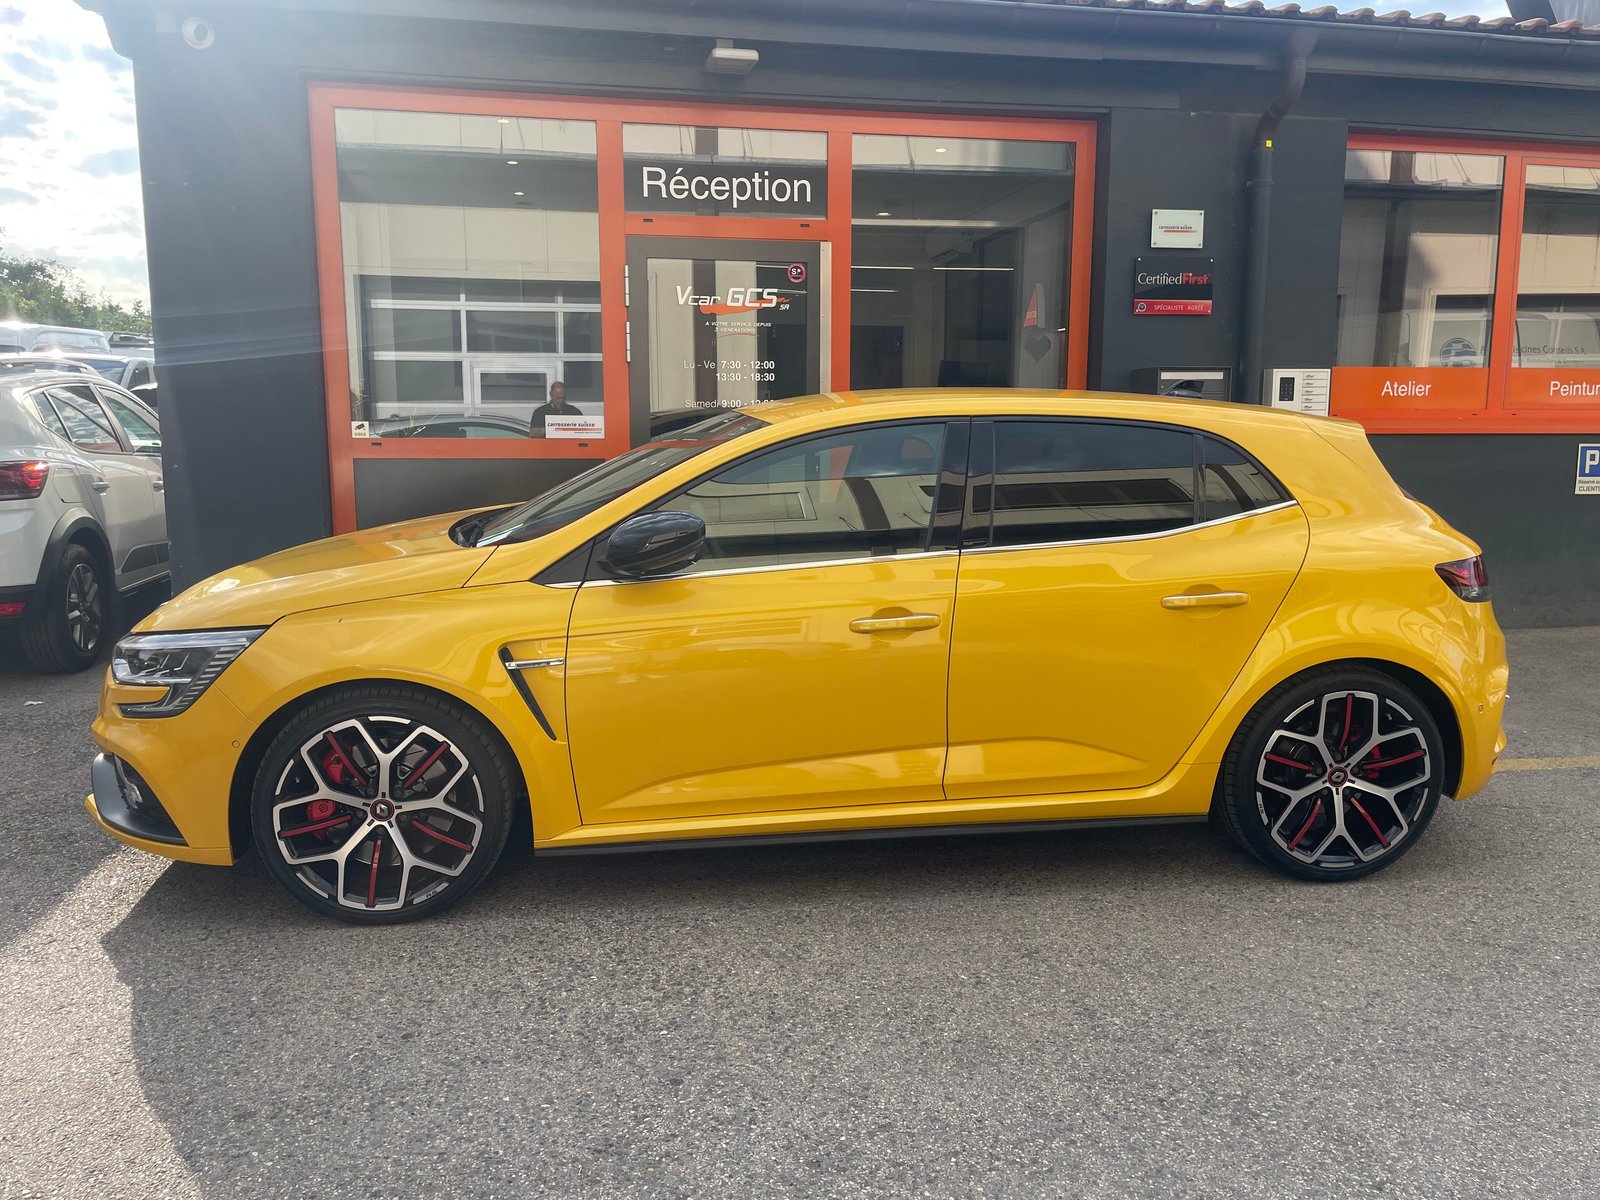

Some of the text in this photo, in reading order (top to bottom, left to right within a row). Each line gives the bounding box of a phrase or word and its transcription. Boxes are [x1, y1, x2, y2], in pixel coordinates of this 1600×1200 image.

[642, 166, 812, 209] Réception
[1137, 272, 1209, 285] CertifiedFirst
[676, 286, 721, 306] Vcar
[726, 287, 779, 308] GCS
[1513, 345, 1541, 354] iscines
[1542, 345, 1573, 355] Conseils
[683, 361, 695, 369] Lu
[703, 361, 716, 369] Ve
[721, 361, 741, 369] 7:30
[750, 361, 775, 369] 12:00
[716, 373, 741, 381] 13:30
[750, 373, 775, 381] 18:30
[1381, 381, 1432, 397] Atelier
[684, 400, 719, 408] Samedi
[721, 400, 742, 408] 9:00
[1585, 449, 1600, 474] P
